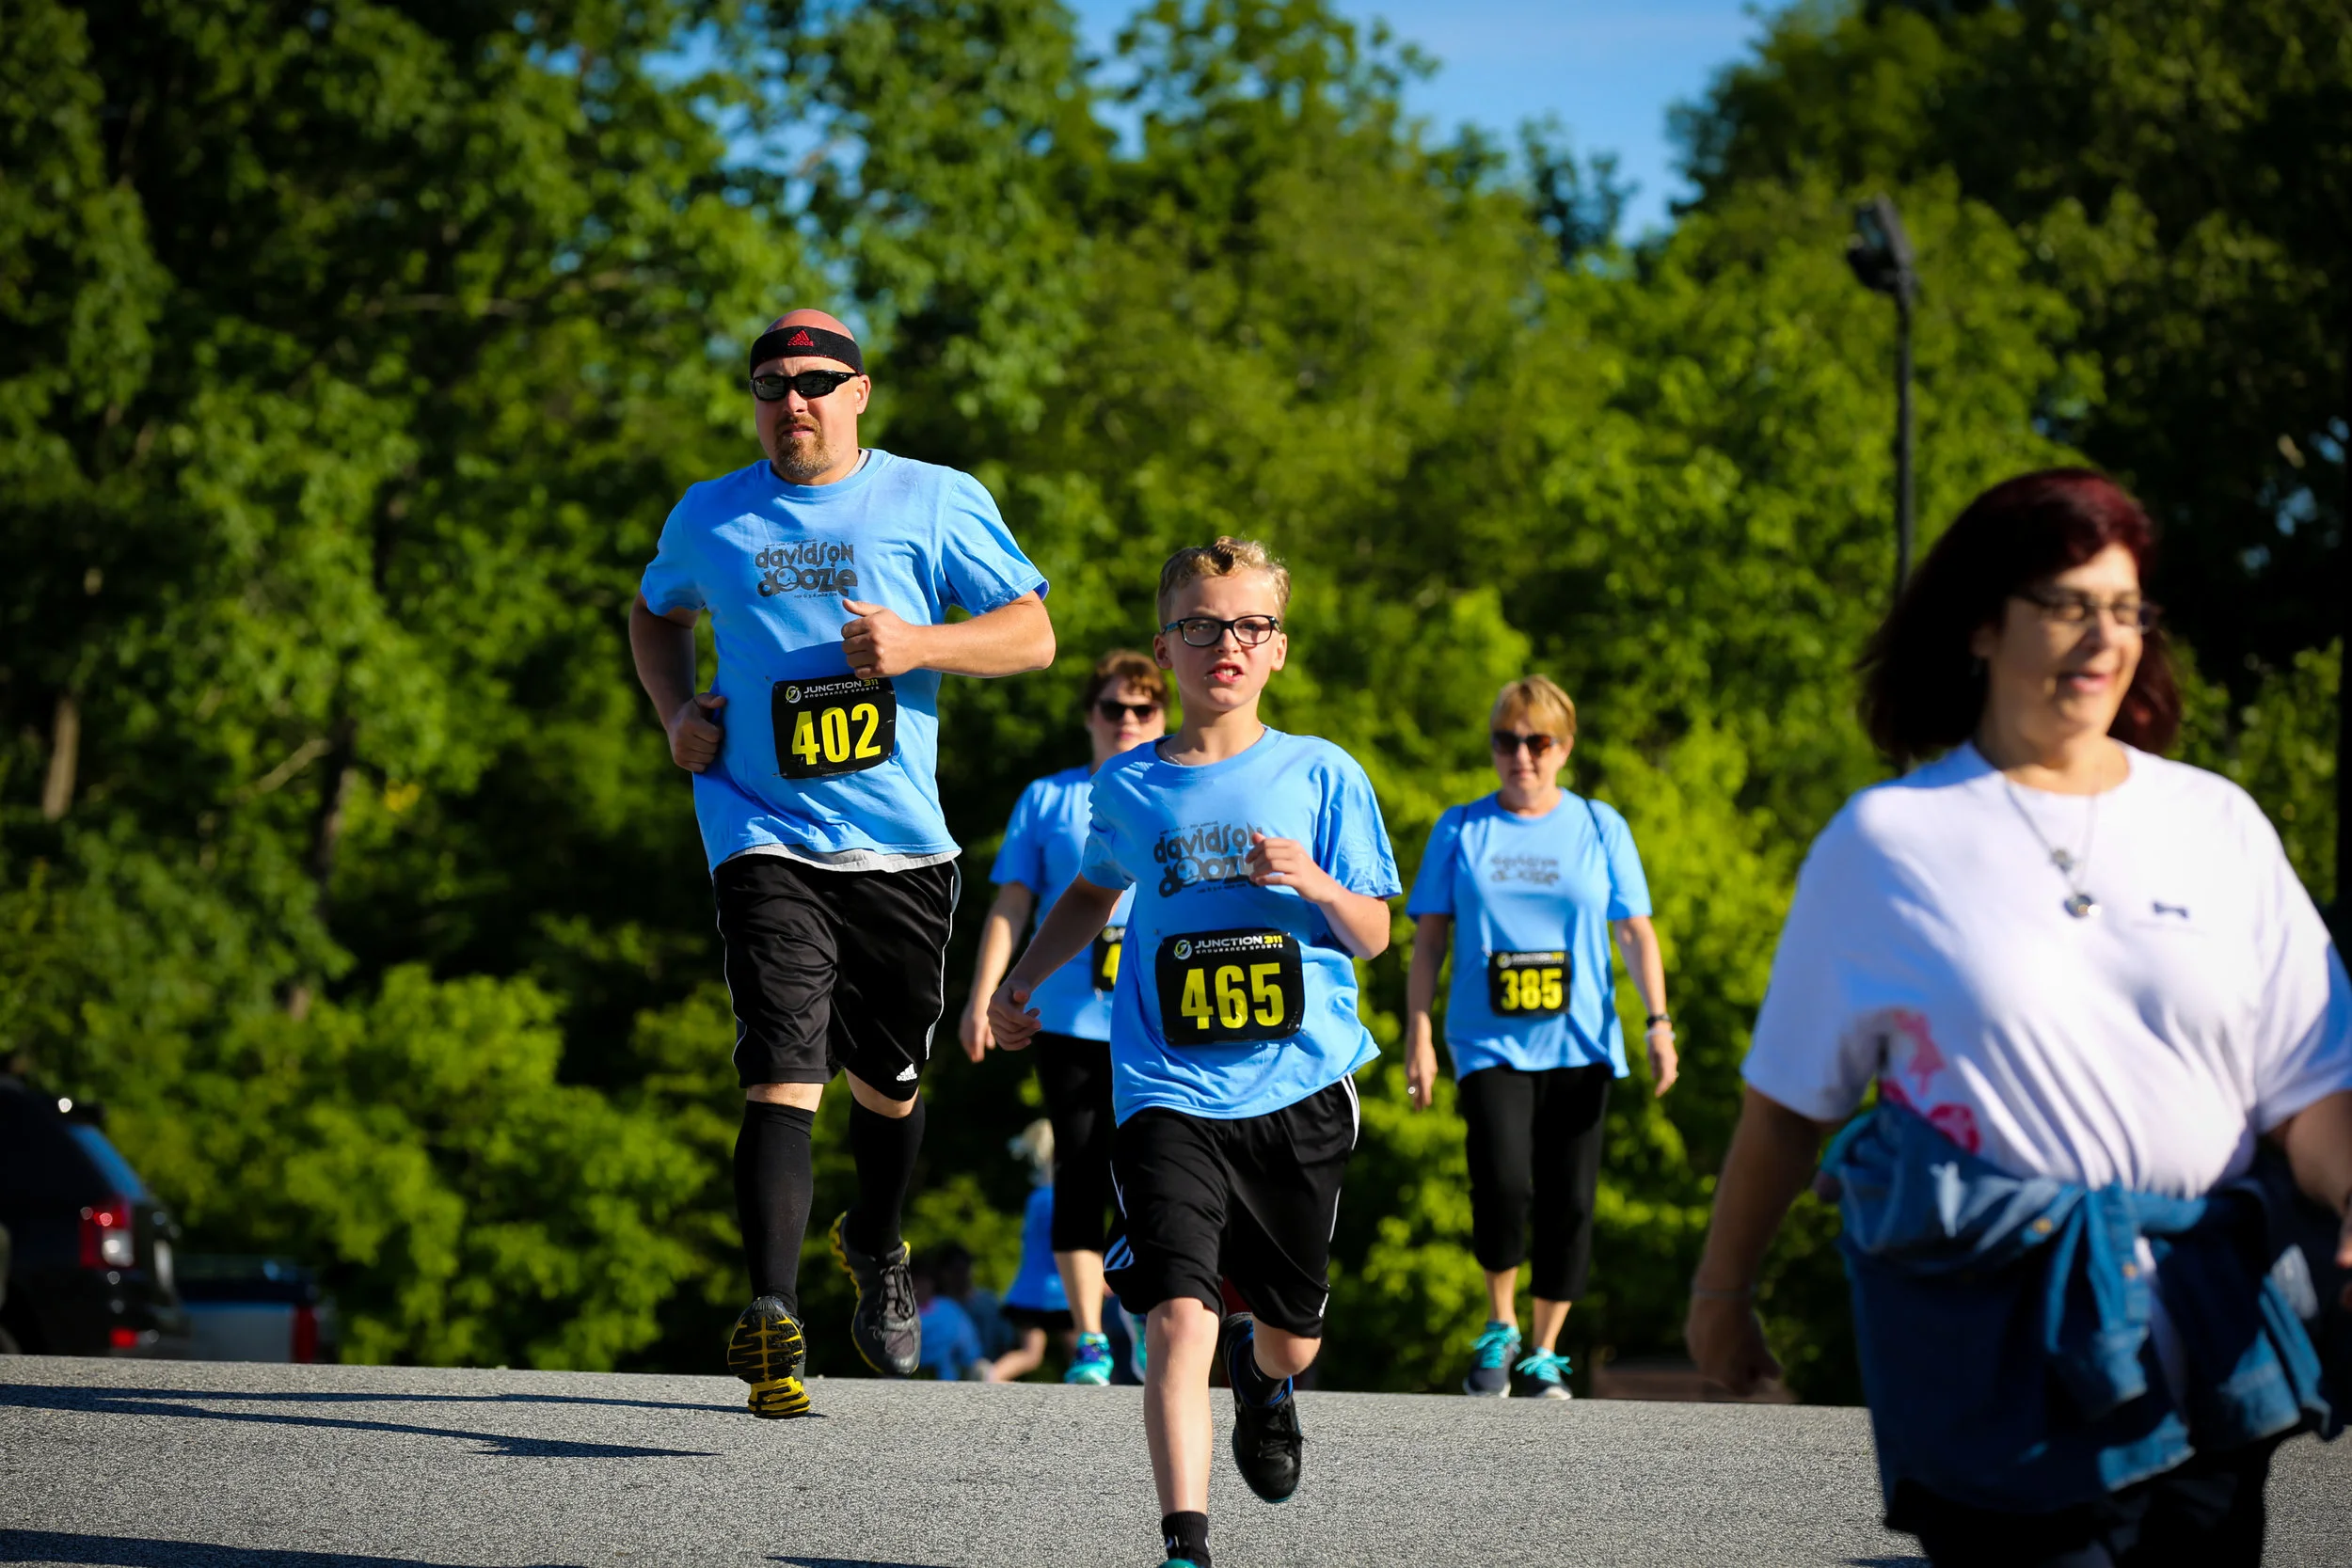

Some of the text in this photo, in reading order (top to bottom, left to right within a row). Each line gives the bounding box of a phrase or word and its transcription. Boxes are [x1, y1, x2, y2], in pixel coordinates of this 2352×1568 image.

[803, 680, 862, 694] JUNCTION
[850, 686, 880, 694] SPORTS
[792, 703, 882, 766] 402
[1195, 935, 1283, 949] JUNCTION 311
[1181, 962, 1284, 1030] 465
[1499, 968, 1563, 1010] 385
